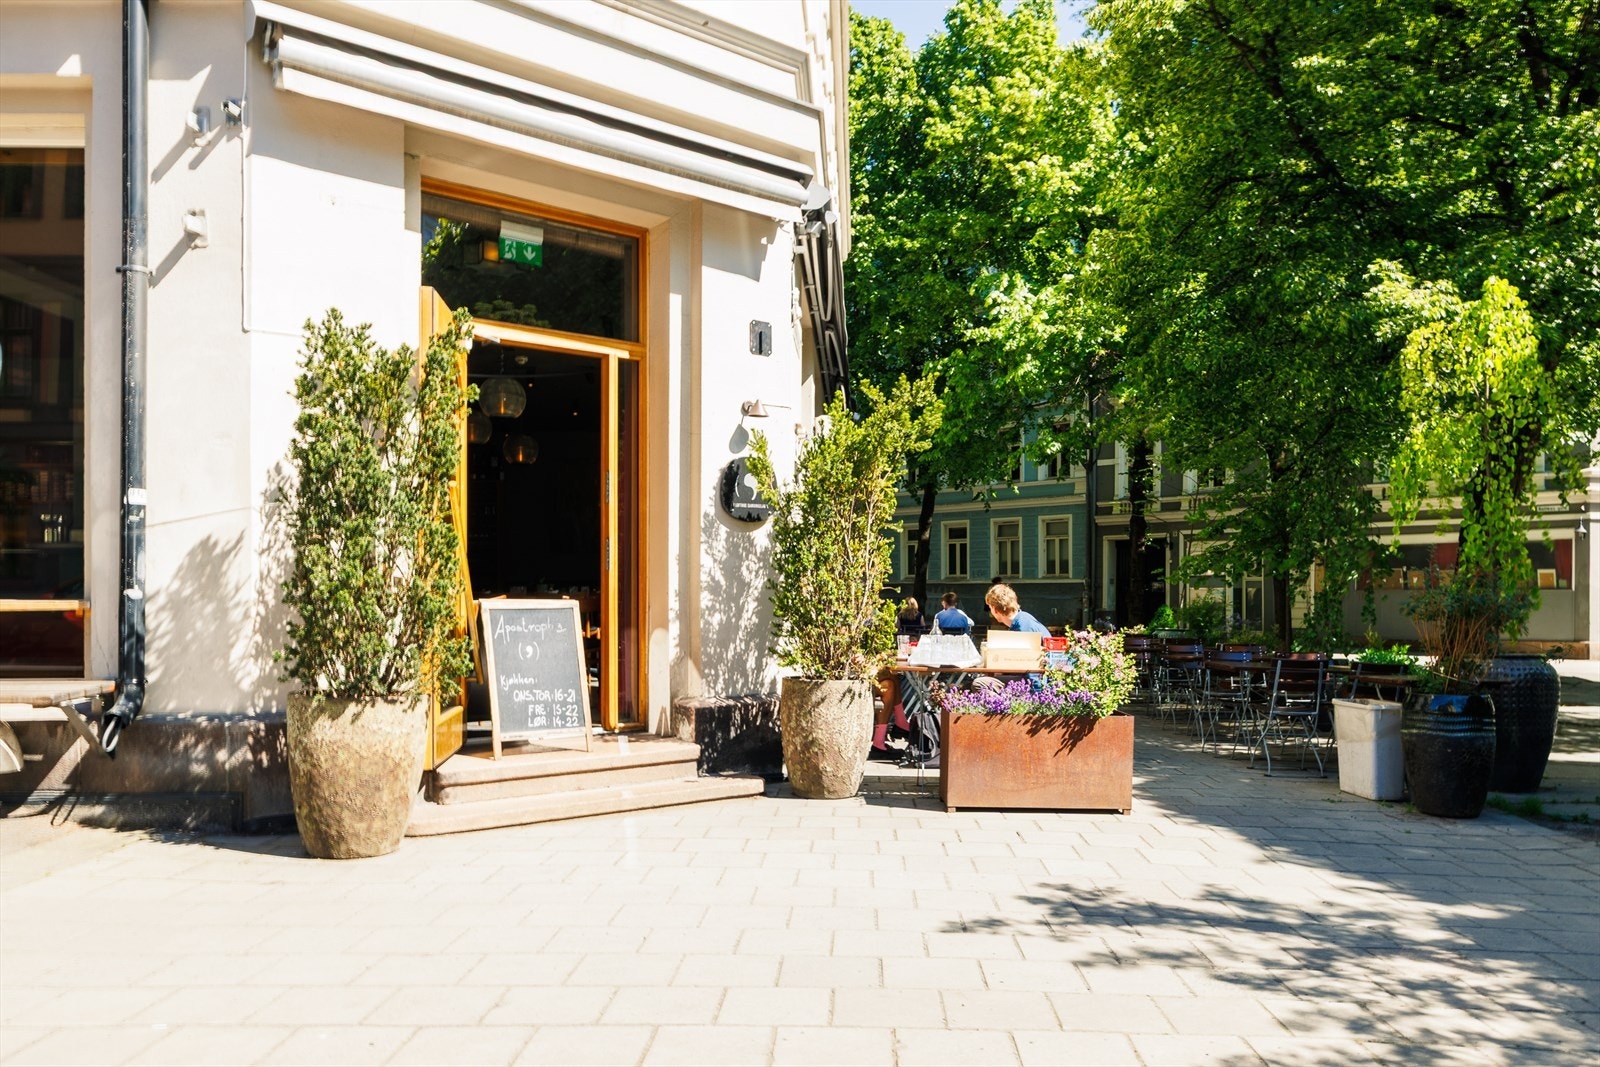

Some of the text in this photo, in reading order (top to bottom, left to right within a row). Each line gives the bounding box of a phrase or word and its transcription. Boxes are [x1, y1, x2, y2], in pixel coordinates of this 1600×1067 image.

[554, 688, 576, 702] 16-21
[552, 703, 579, 717] 15-22
[552, 716, 579, 728] 14-22
